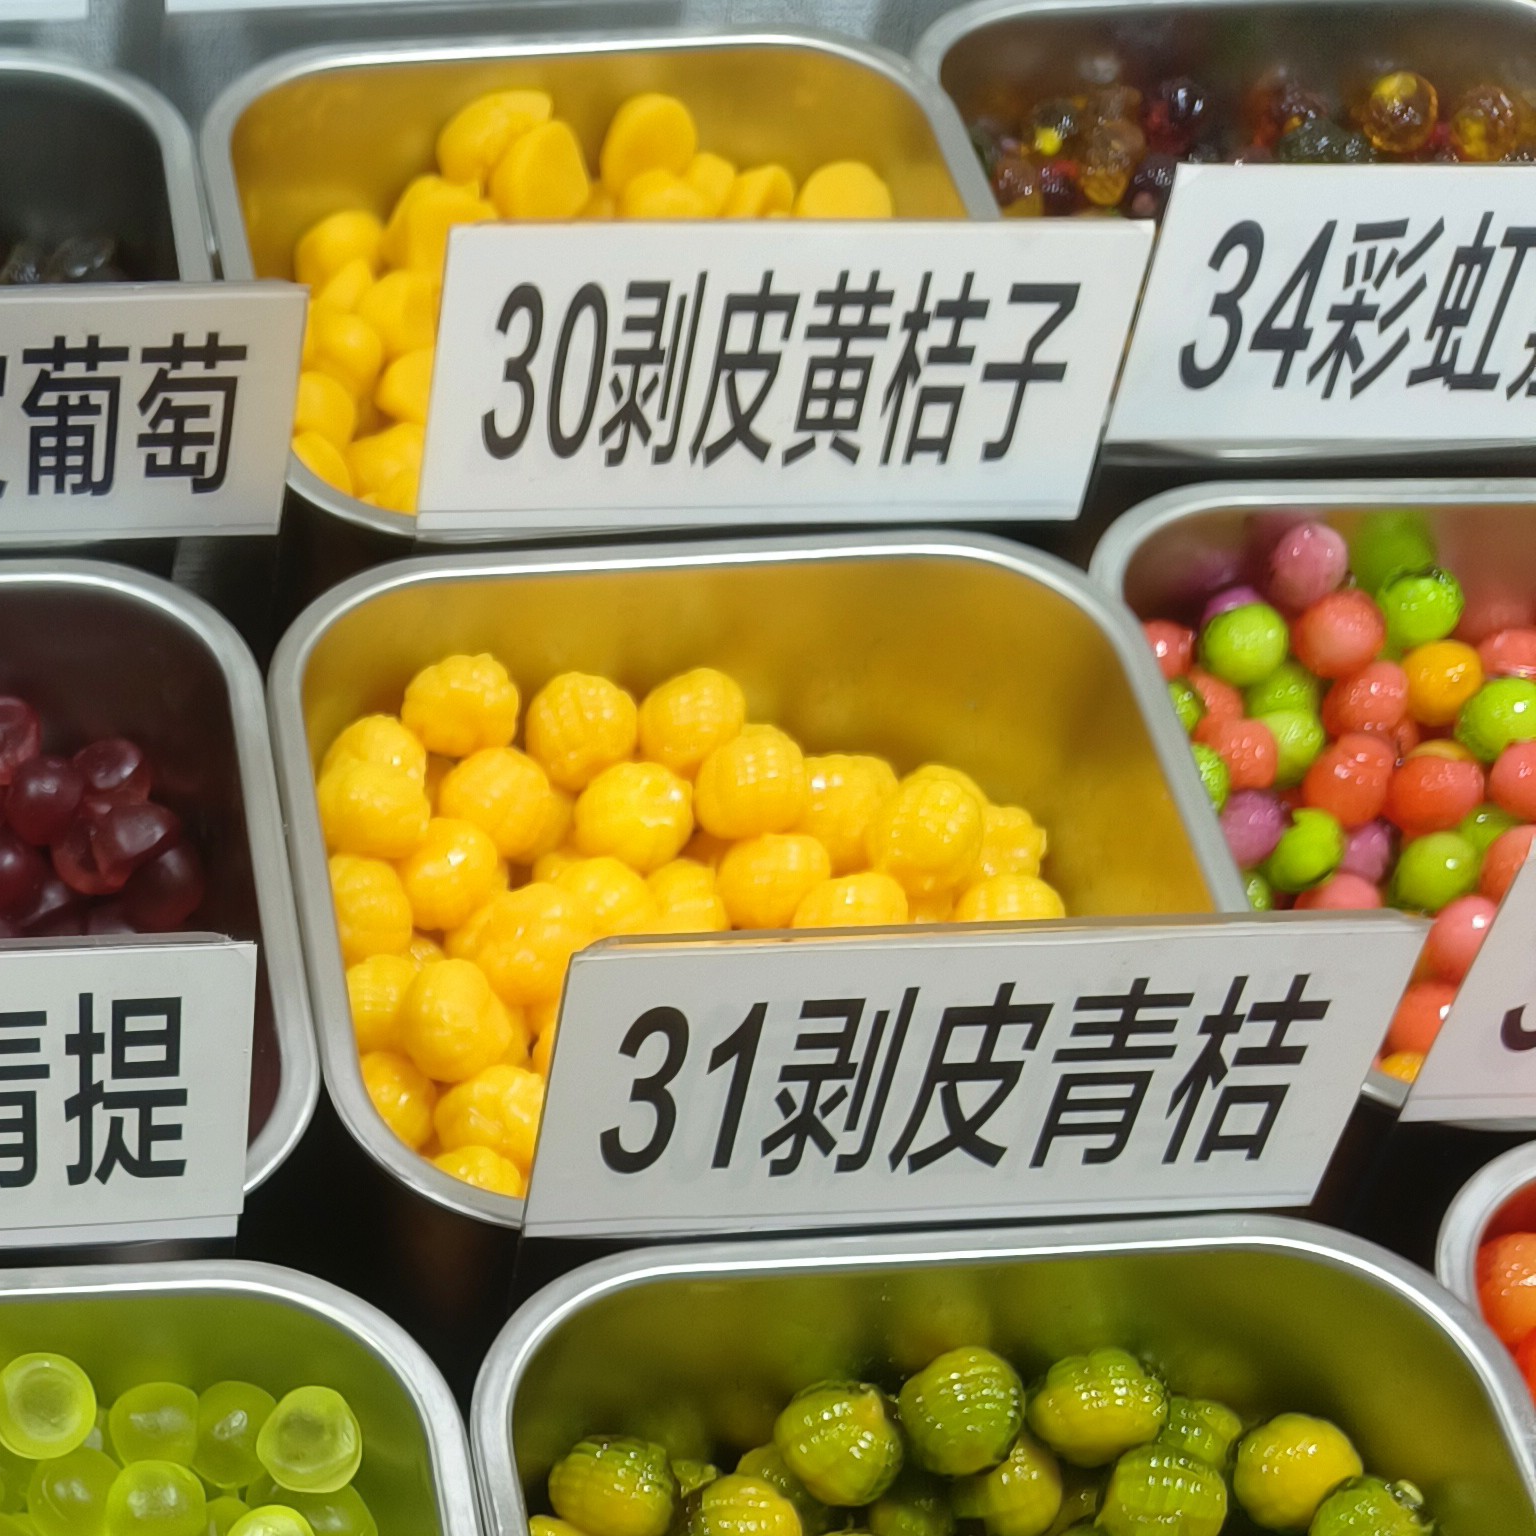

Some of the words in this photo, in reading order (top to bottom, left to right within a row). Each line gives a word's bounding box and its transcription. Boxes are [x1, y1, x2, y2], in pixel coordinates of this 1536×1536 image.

[482, 270, 1080, 467] 30剥皮黄桔子
[1179, 211, 1536, 400] 34彩虹
[600, 974, 1331, 1176] 31剥皮青桔
